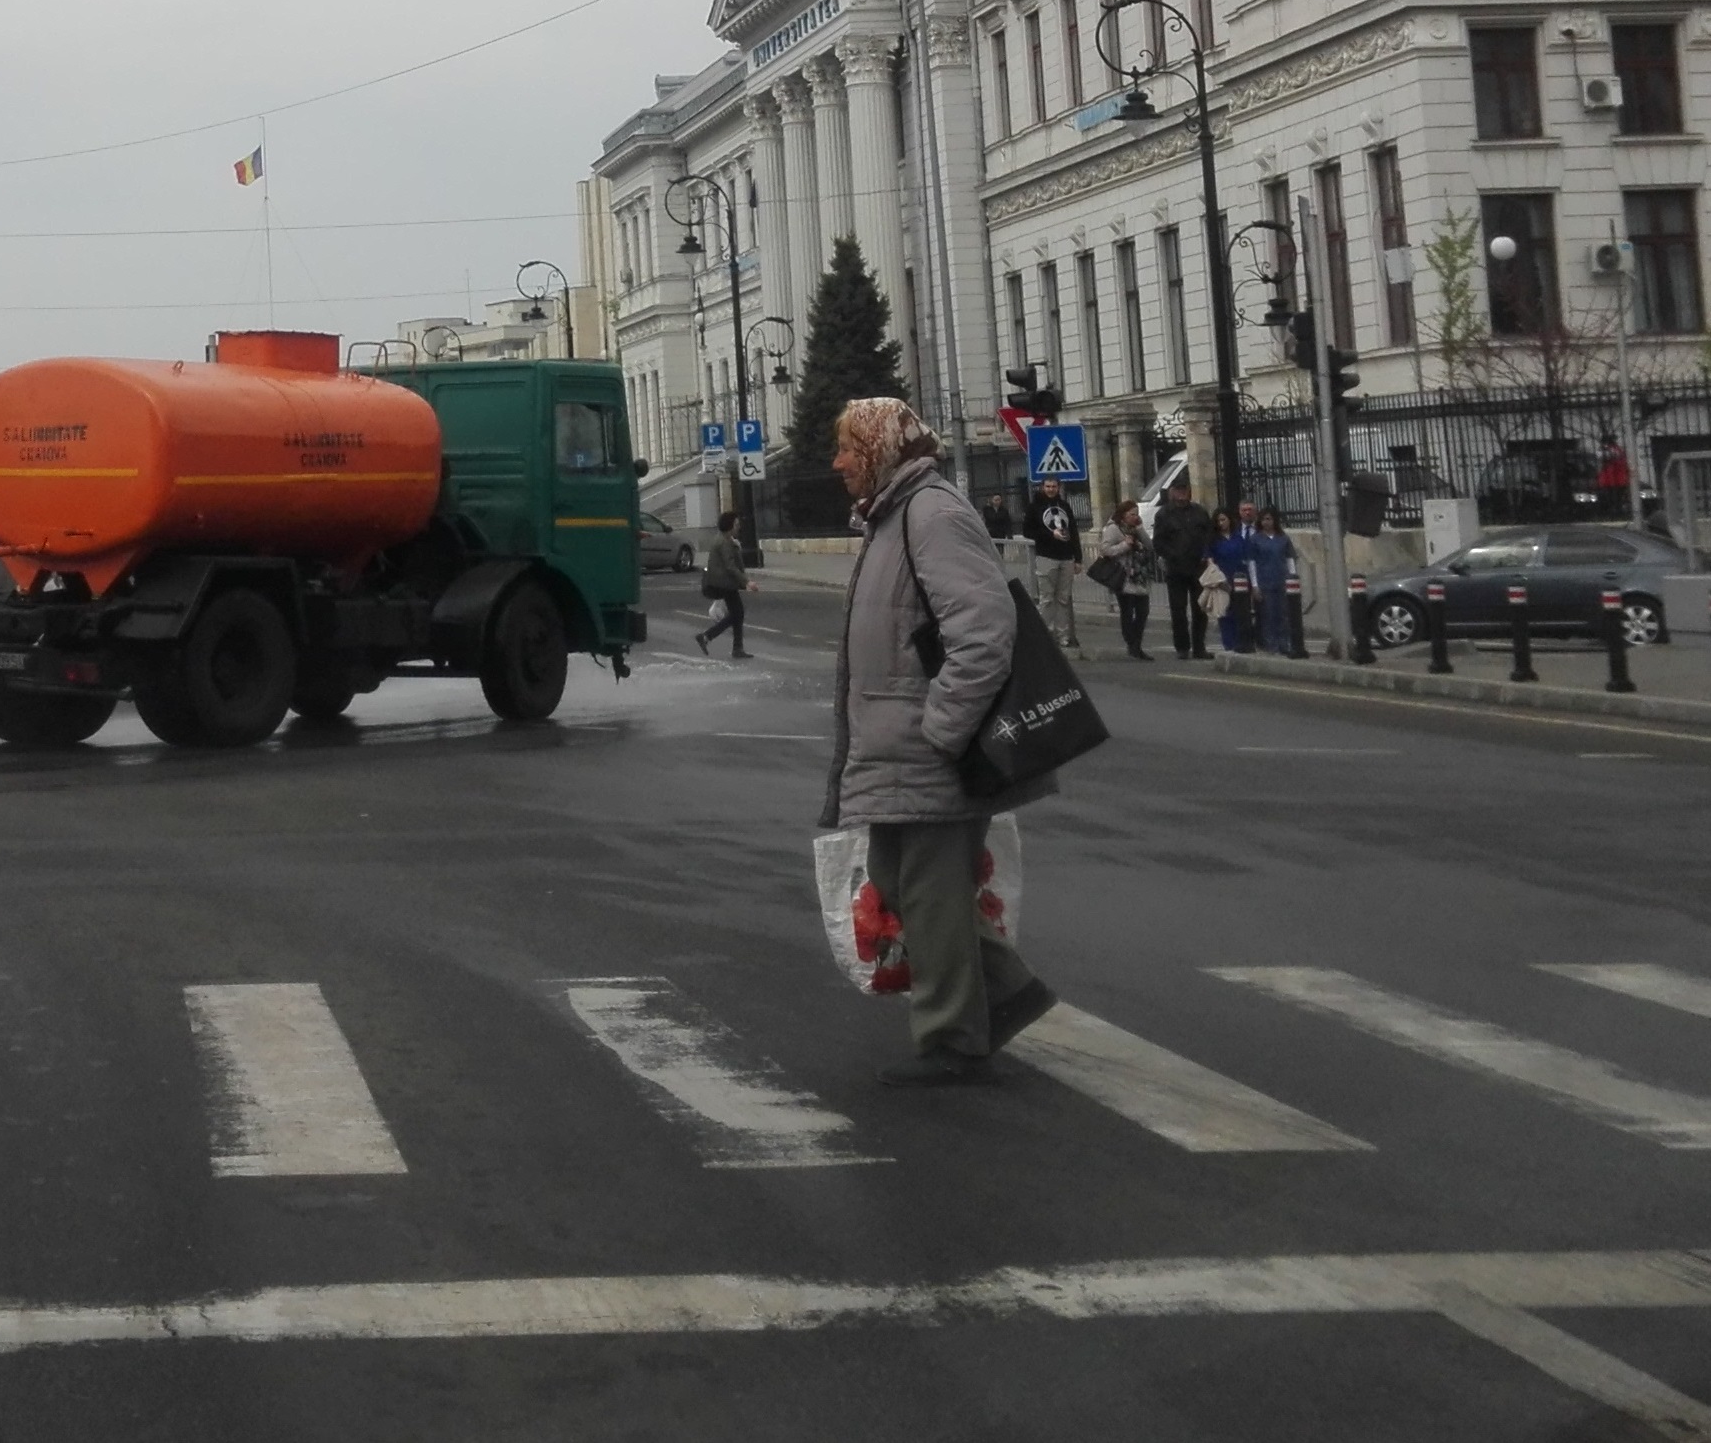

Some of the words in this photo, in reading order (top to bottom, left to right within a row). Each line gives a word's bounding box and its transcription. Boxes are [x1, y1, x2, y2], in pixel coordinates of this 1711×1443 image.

[708, 426, 720, 443] P
[743, 423, 755, 442] P
[1019, 710, 1038, 723] La
[1036, 688, 1082, 716] Bussola
